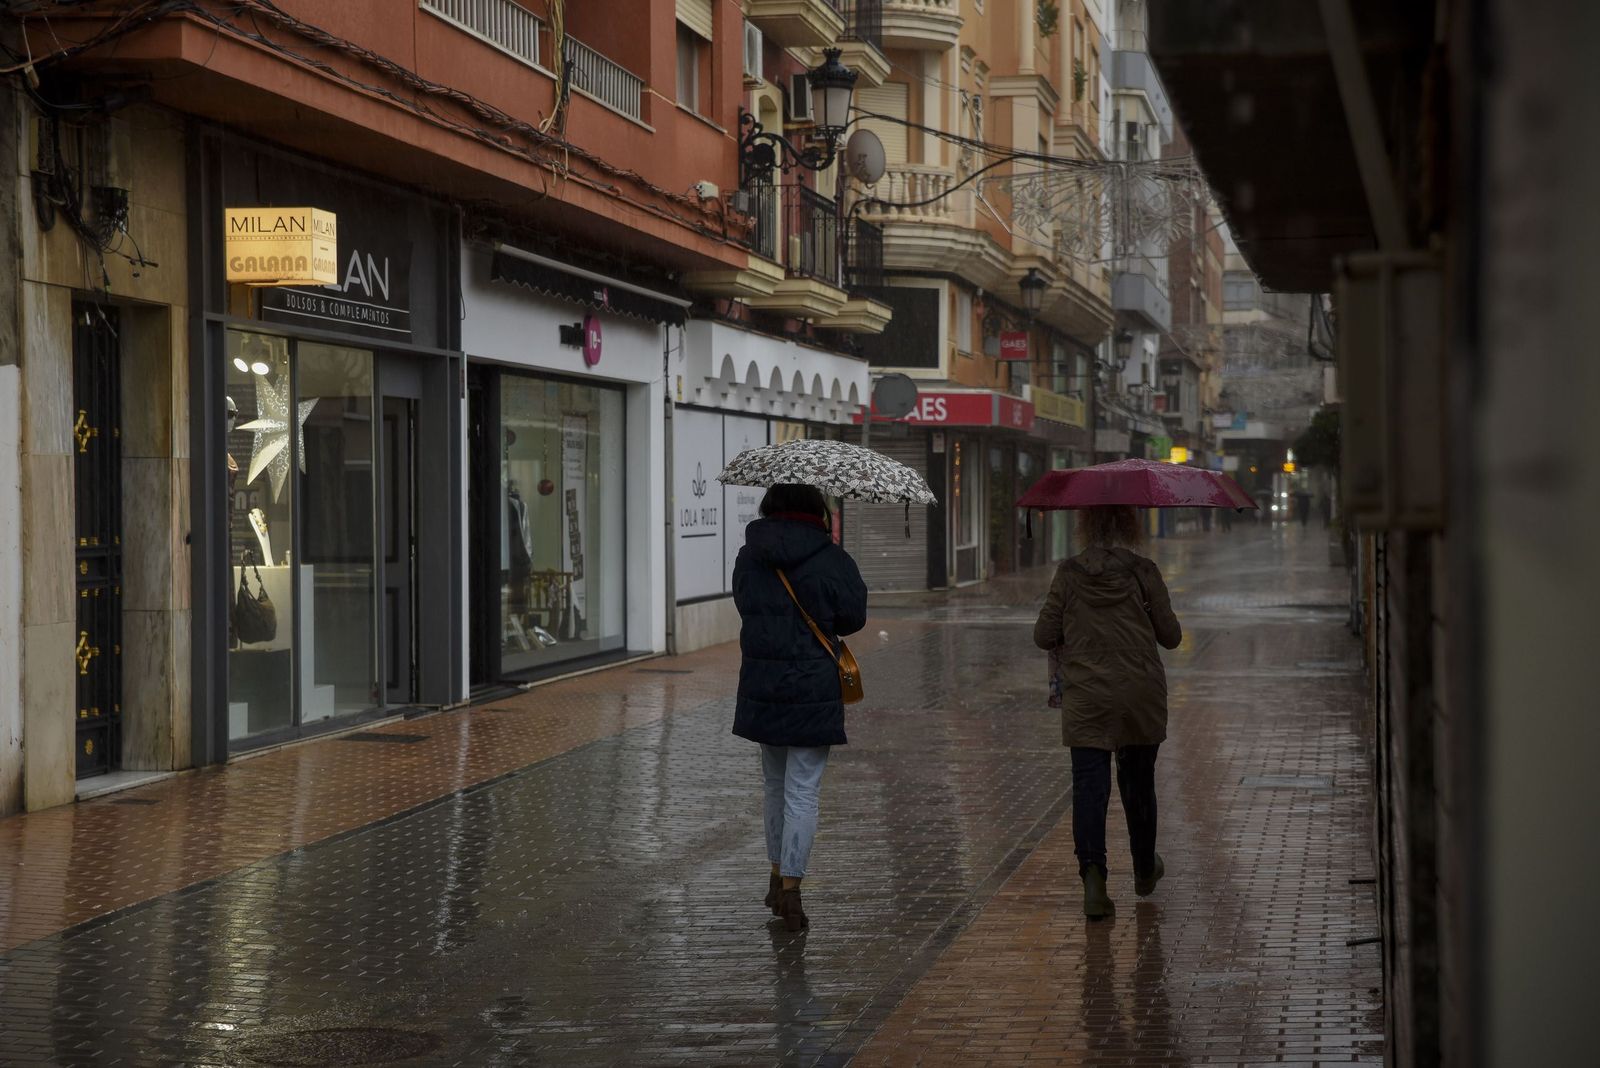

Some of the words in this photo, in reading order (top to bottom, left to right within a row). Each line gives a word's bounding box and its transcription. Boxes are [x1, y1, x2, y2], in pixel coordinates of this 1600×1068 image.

[231, 216, 306, 233] MILAN
[313, 219, 335, 237] MILAN
[229, 255, 308, 273] GALANA
[286, 293, 317, 312] BOLSOS
[320, 300, 326, 313] &
[329, 302, 390, 325] COMPLEMENTOS
[1001, 339, 1026, 349] GAES
[902, 397, 948, 421] AES
[680, 508, 698, 527] LOLA
[701, 508, 717, 526] RUIZ
